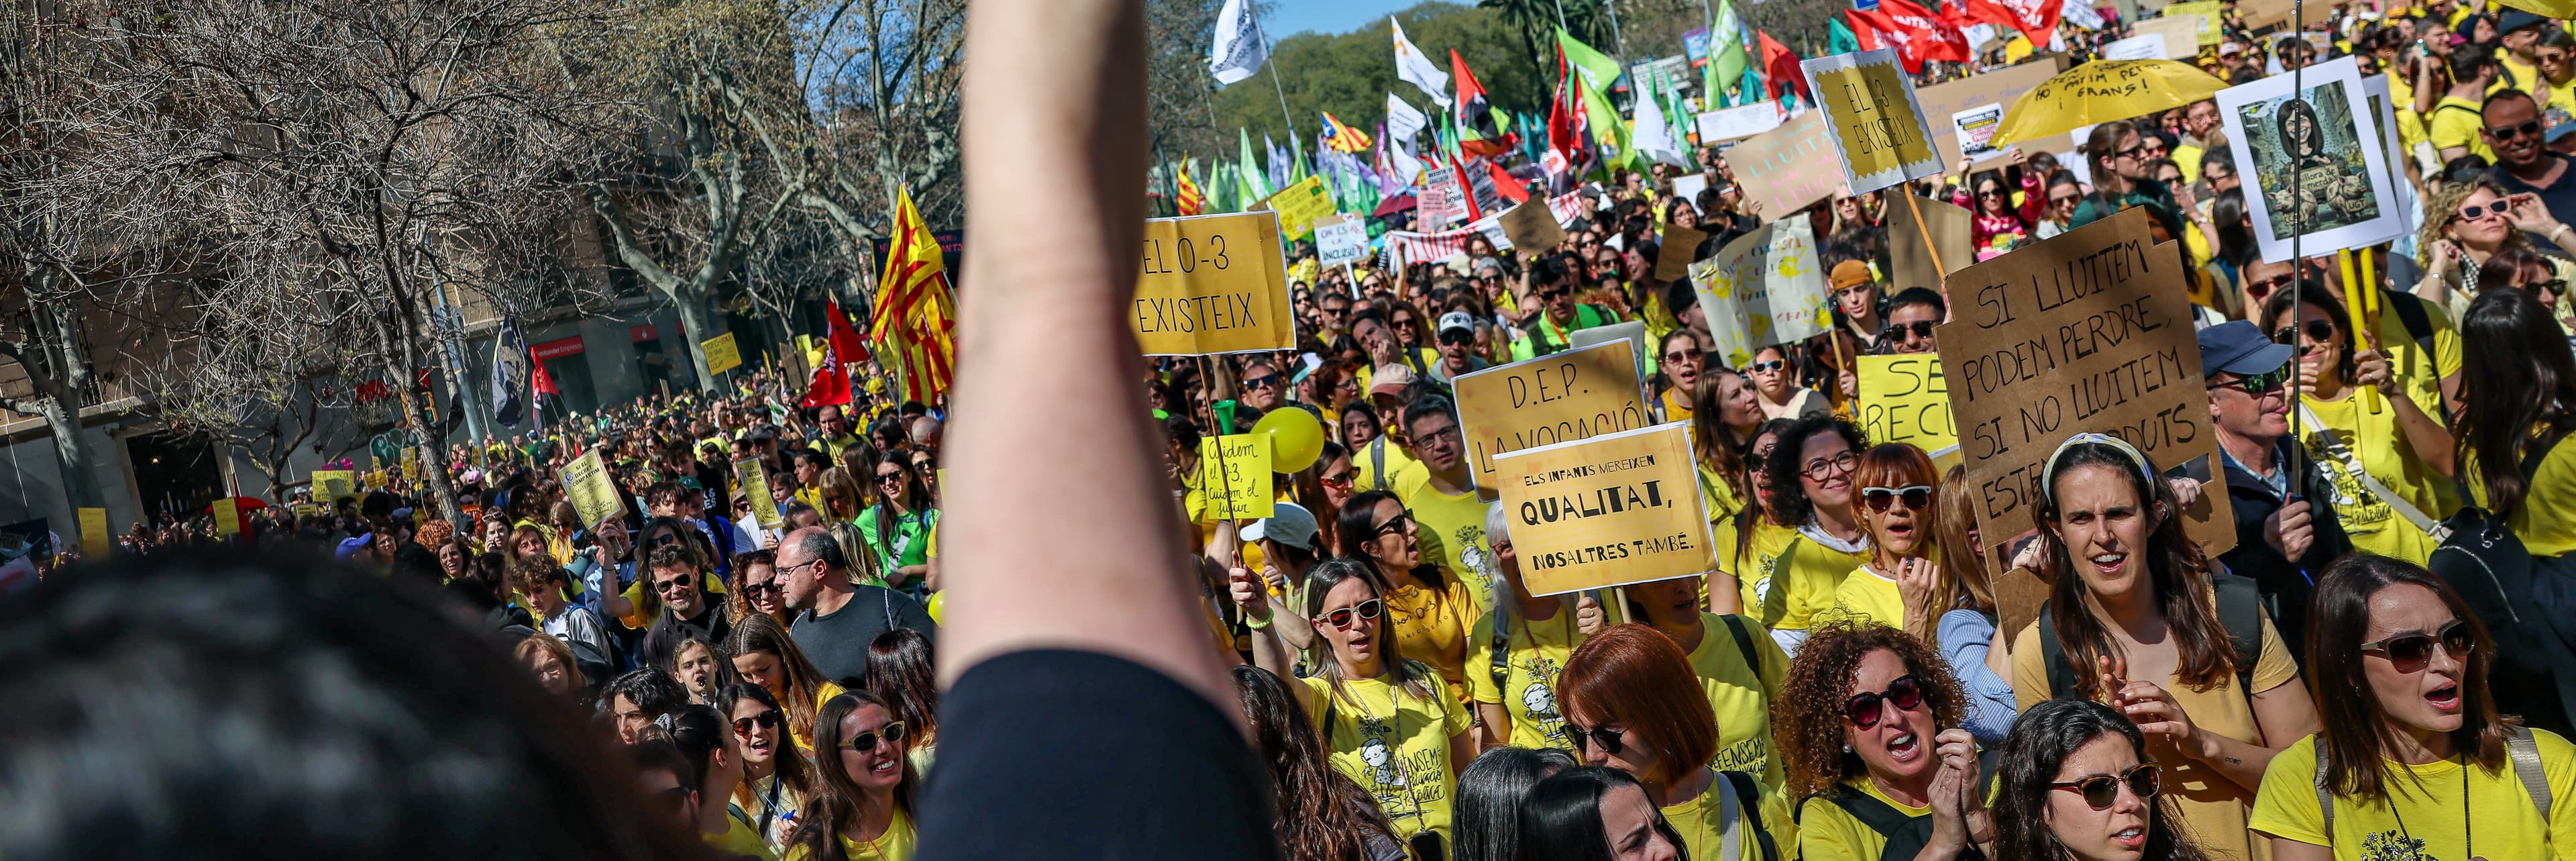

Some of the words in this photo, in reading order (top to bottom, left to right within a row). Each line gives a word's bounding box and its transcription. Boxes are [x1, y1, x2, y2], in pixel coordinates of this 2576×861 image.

[1844, 83, 1871, 113] EL
[2297, 171, 2324, 185] illora
[2326, 167, 2335, 176] de
[1142, 239, 1173, 274] EL
[1976, 283, 2016, 329] SI
[2032, 239, 2149, 312] LLUITEM
[1136, 292, 1256, 333] EXISTEIX
[1962, 334, 2056, 402] PODEM
[2059, 295, 2172, 364] PERDRE,
[1508, 363, 1588, 409] D.E.P.
[1974, 416, 2009, 460] SI
[2020, 395, 2061, 444] NO
[2070, 345, 2186, 421] LLUITEM
[1477, 437, 1507, 473] LA
[1516, 401, 1642, 449] VOCACIÓ
[572, 467, 600, 487] COMPARTIM
[1247, 477, 1259, 498] el
[1524, 474, 1546, 487] ELS
[1549, 465, 1596, 483] INFANTS
[1599, 454, 1656, 474] MEREIXEN
[1520, 480, 1672, 526] QUALITAT,
[1532, 542, 1629, 570] NOSALTRES
[1633, 532, 1695, 556] TAMBÉ.
